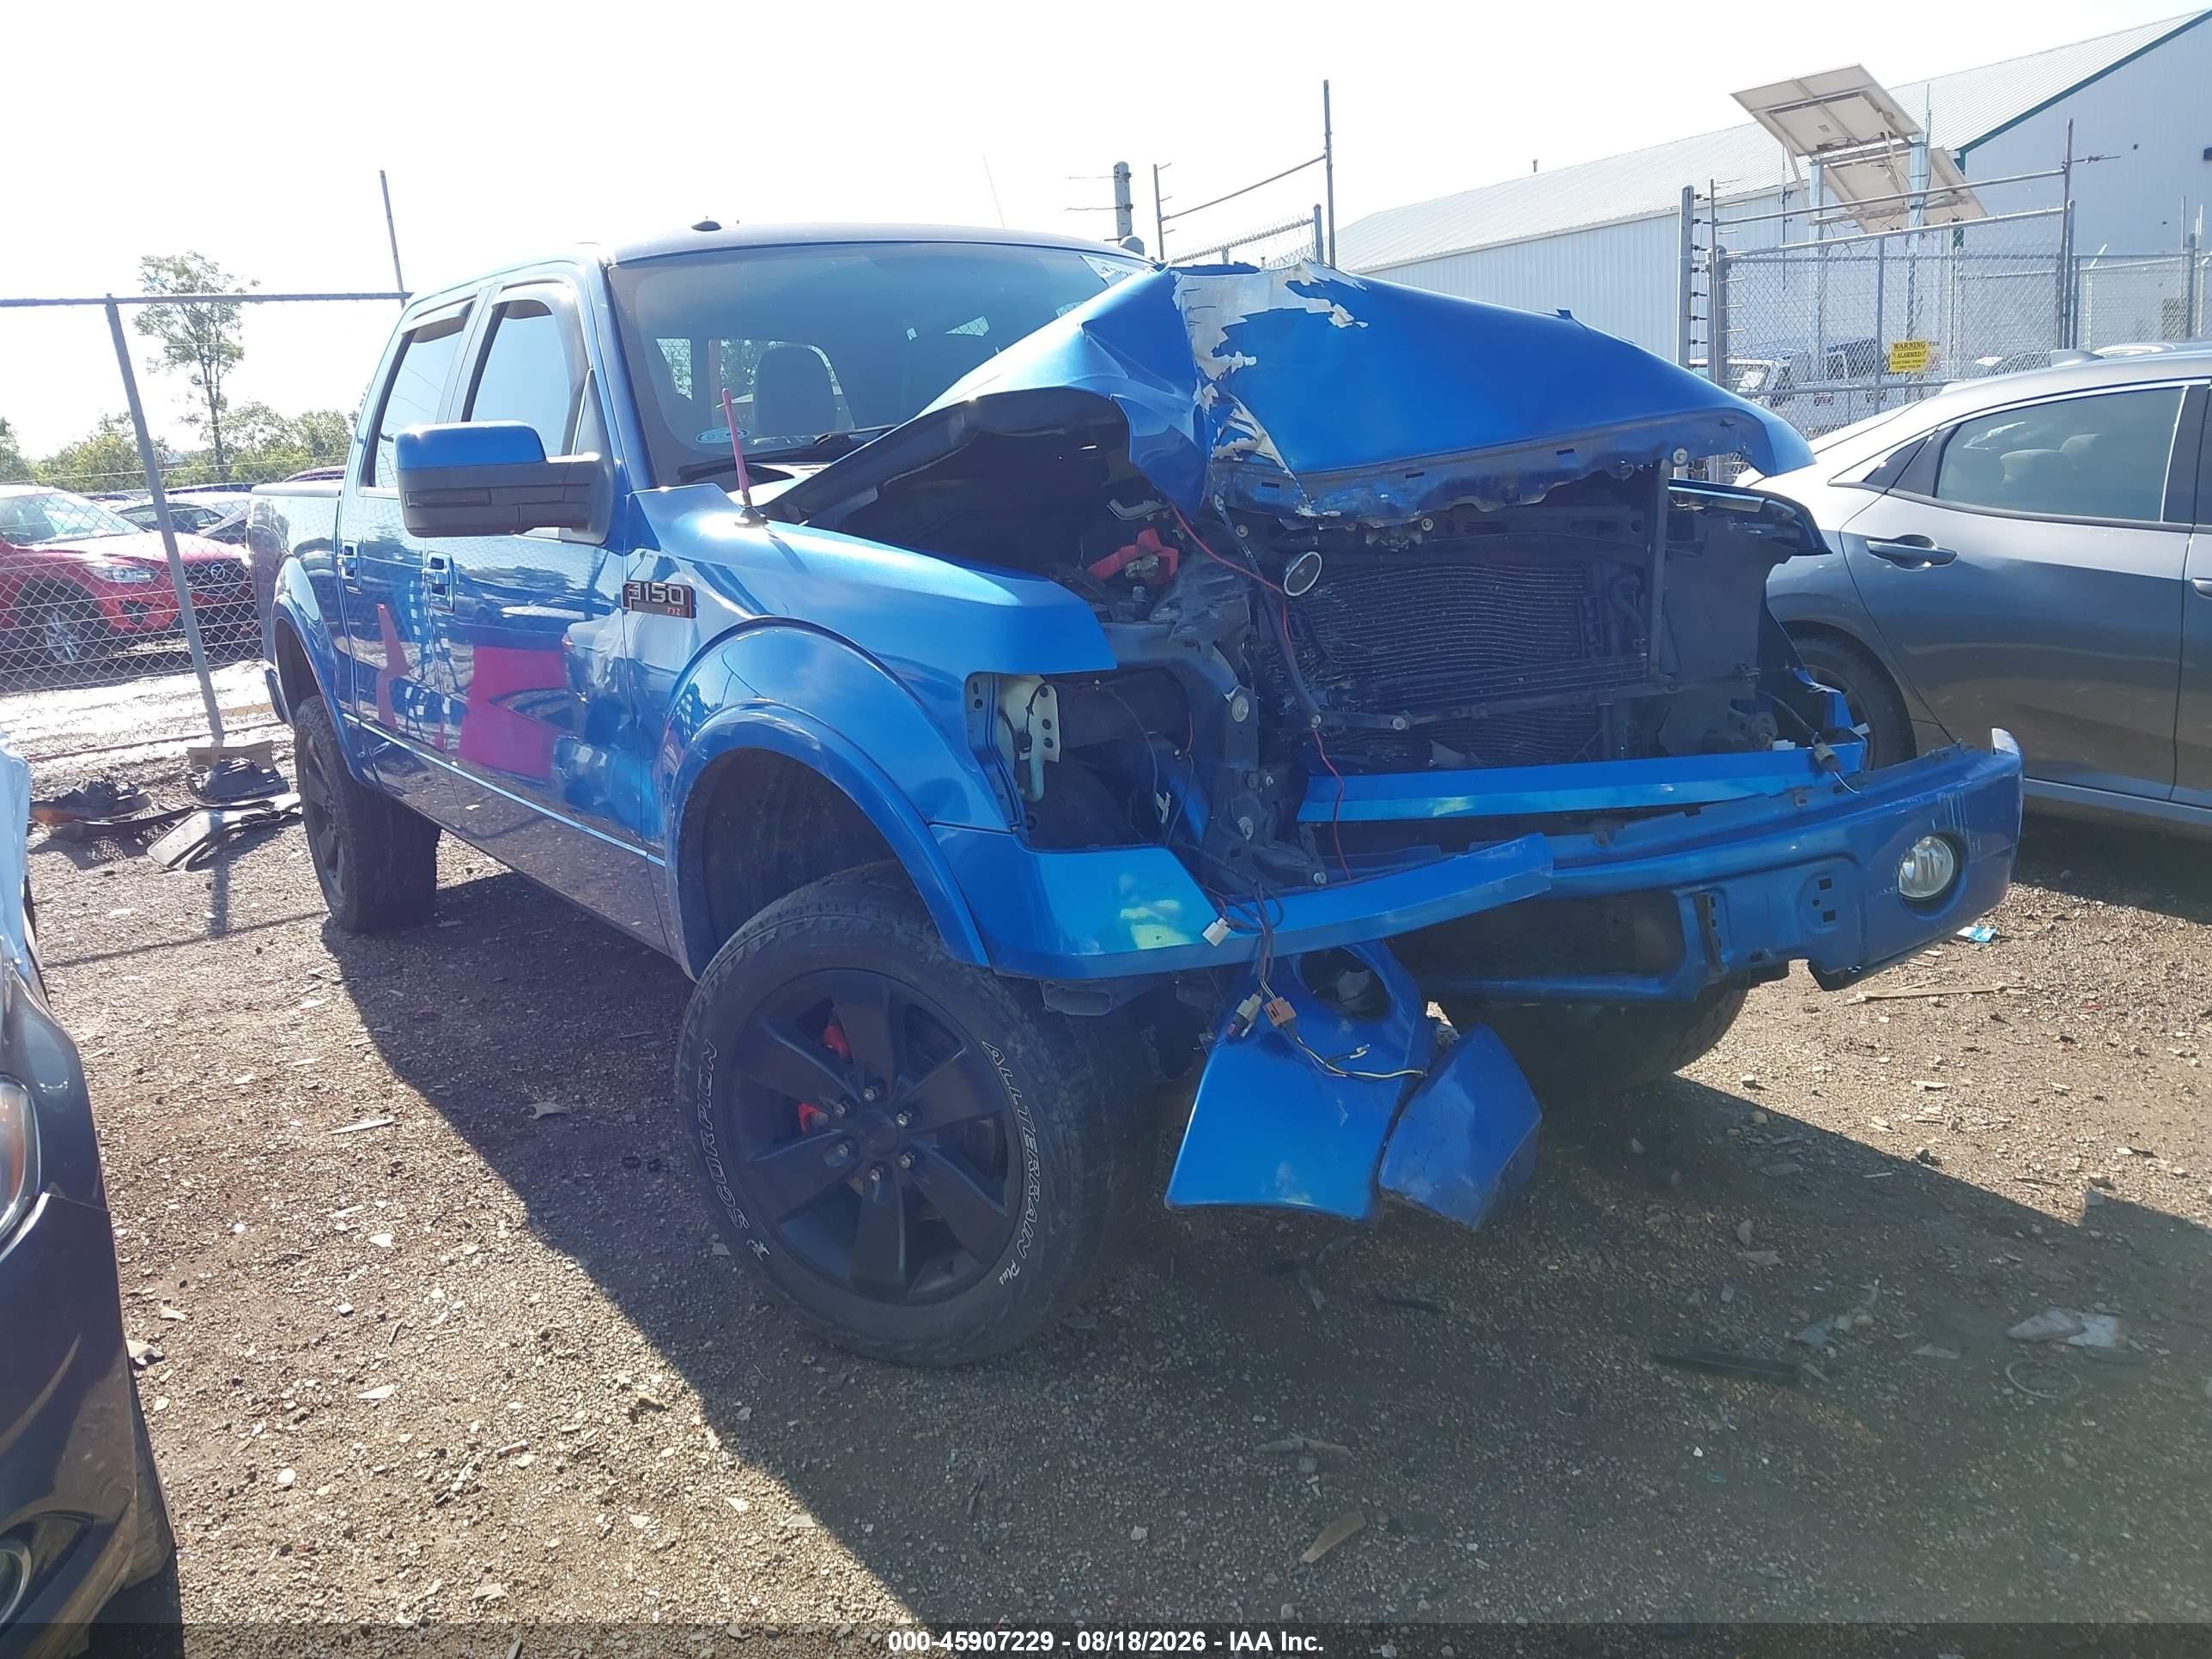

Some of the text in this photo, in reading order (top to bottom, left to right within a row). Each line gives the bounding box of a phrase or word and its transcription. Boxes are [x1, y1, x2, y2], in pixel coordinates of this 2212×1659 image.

[667, 606, 682, 617] FX2
[696, 1037, 750, 1231] SCORPION
[998, 1258, 1021, 1285] Plus
